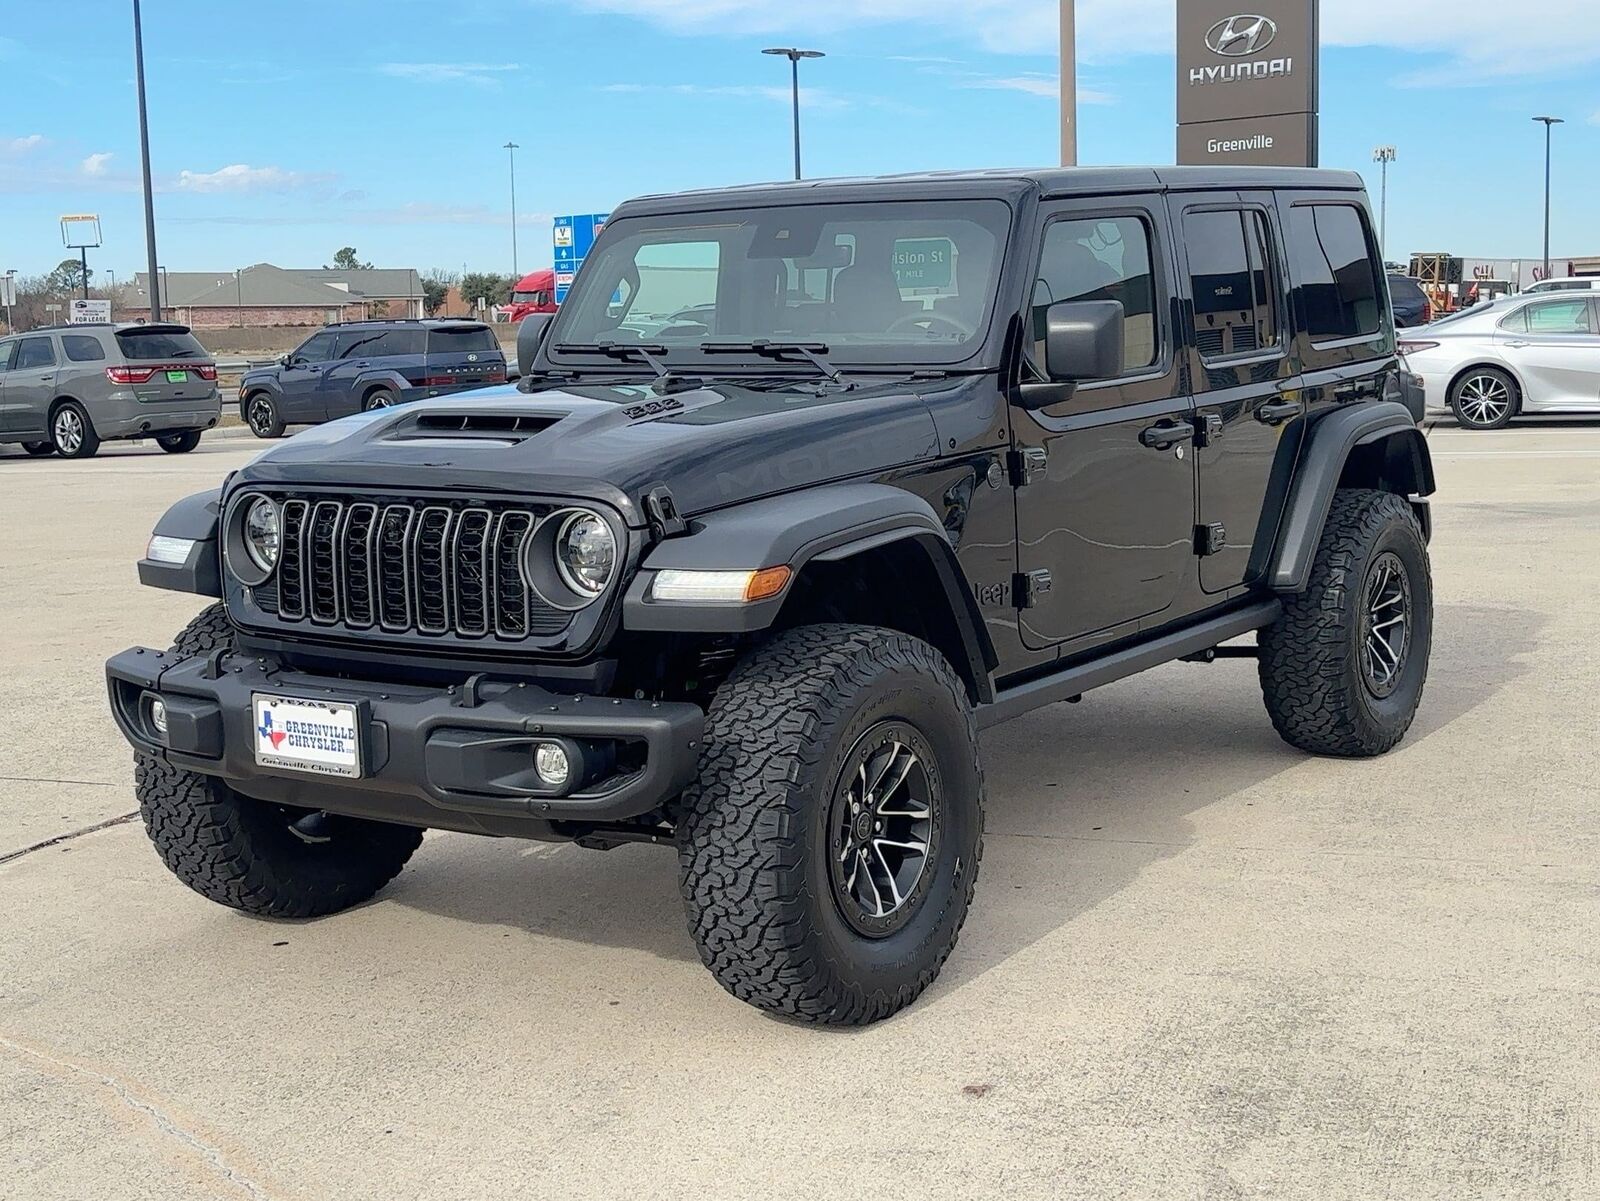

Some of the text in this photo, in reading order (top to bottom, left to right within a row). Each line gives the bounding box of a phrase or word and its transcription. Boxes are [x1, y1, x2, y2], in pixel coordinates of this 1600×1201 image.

[1189, 57, 1292, 86] HYUNDAI
[1207, 134, 1274, 154] Greenville
[931, 250, 944, 263] St
[896, 269, 924, 281] 1 MILE
[974, 581, 1009, 606] Jeep
[279, 697, 328, 709] TEXAS
[285, 720, 355, 741] GREENVILLE
[288, 734, 346, 753] CHRYSLER
[261, 756, 352, 775] Greenville Chrysler
